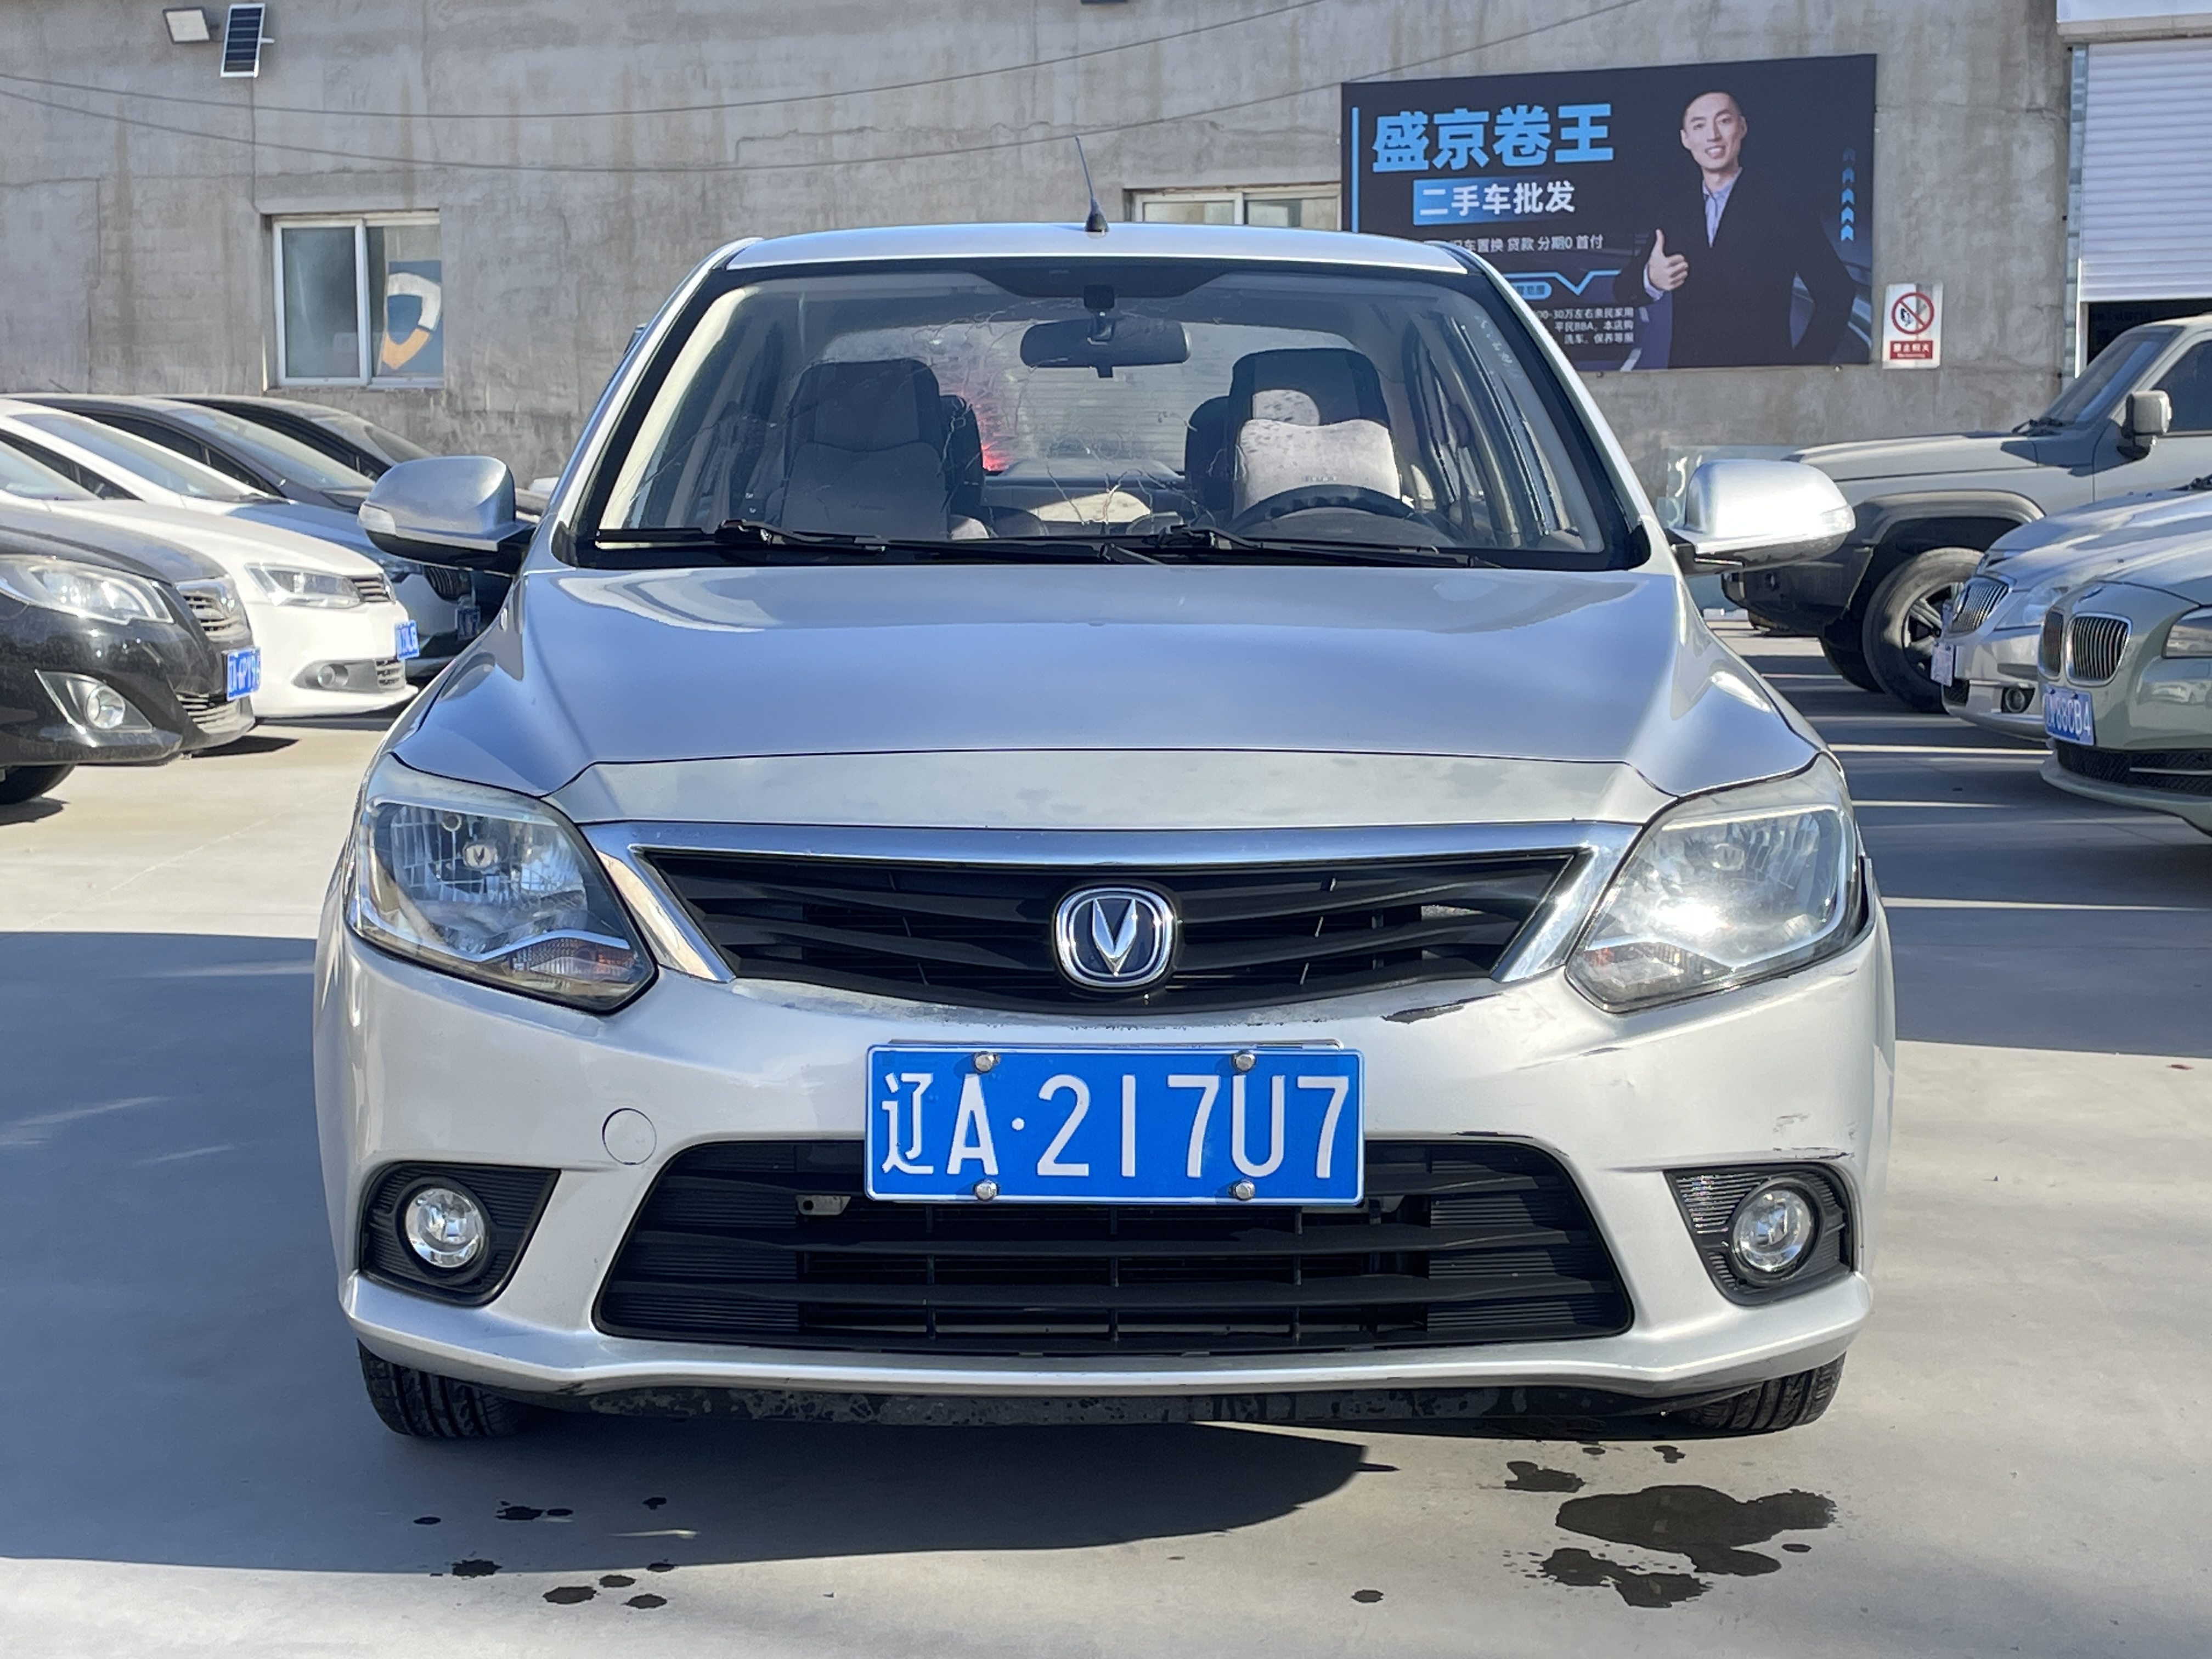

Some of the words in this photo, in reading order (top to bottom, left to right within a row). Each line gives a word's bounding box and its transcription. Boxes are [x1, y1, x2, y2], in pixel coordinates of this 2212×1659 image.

[1372, 104, 1613, 172] 盛京卷王
[1420, 180, 1575, 216] 二手车批发
[1507, 236, 1534, 252] 贷款
[1576, 234, 1603, 250] 首付
